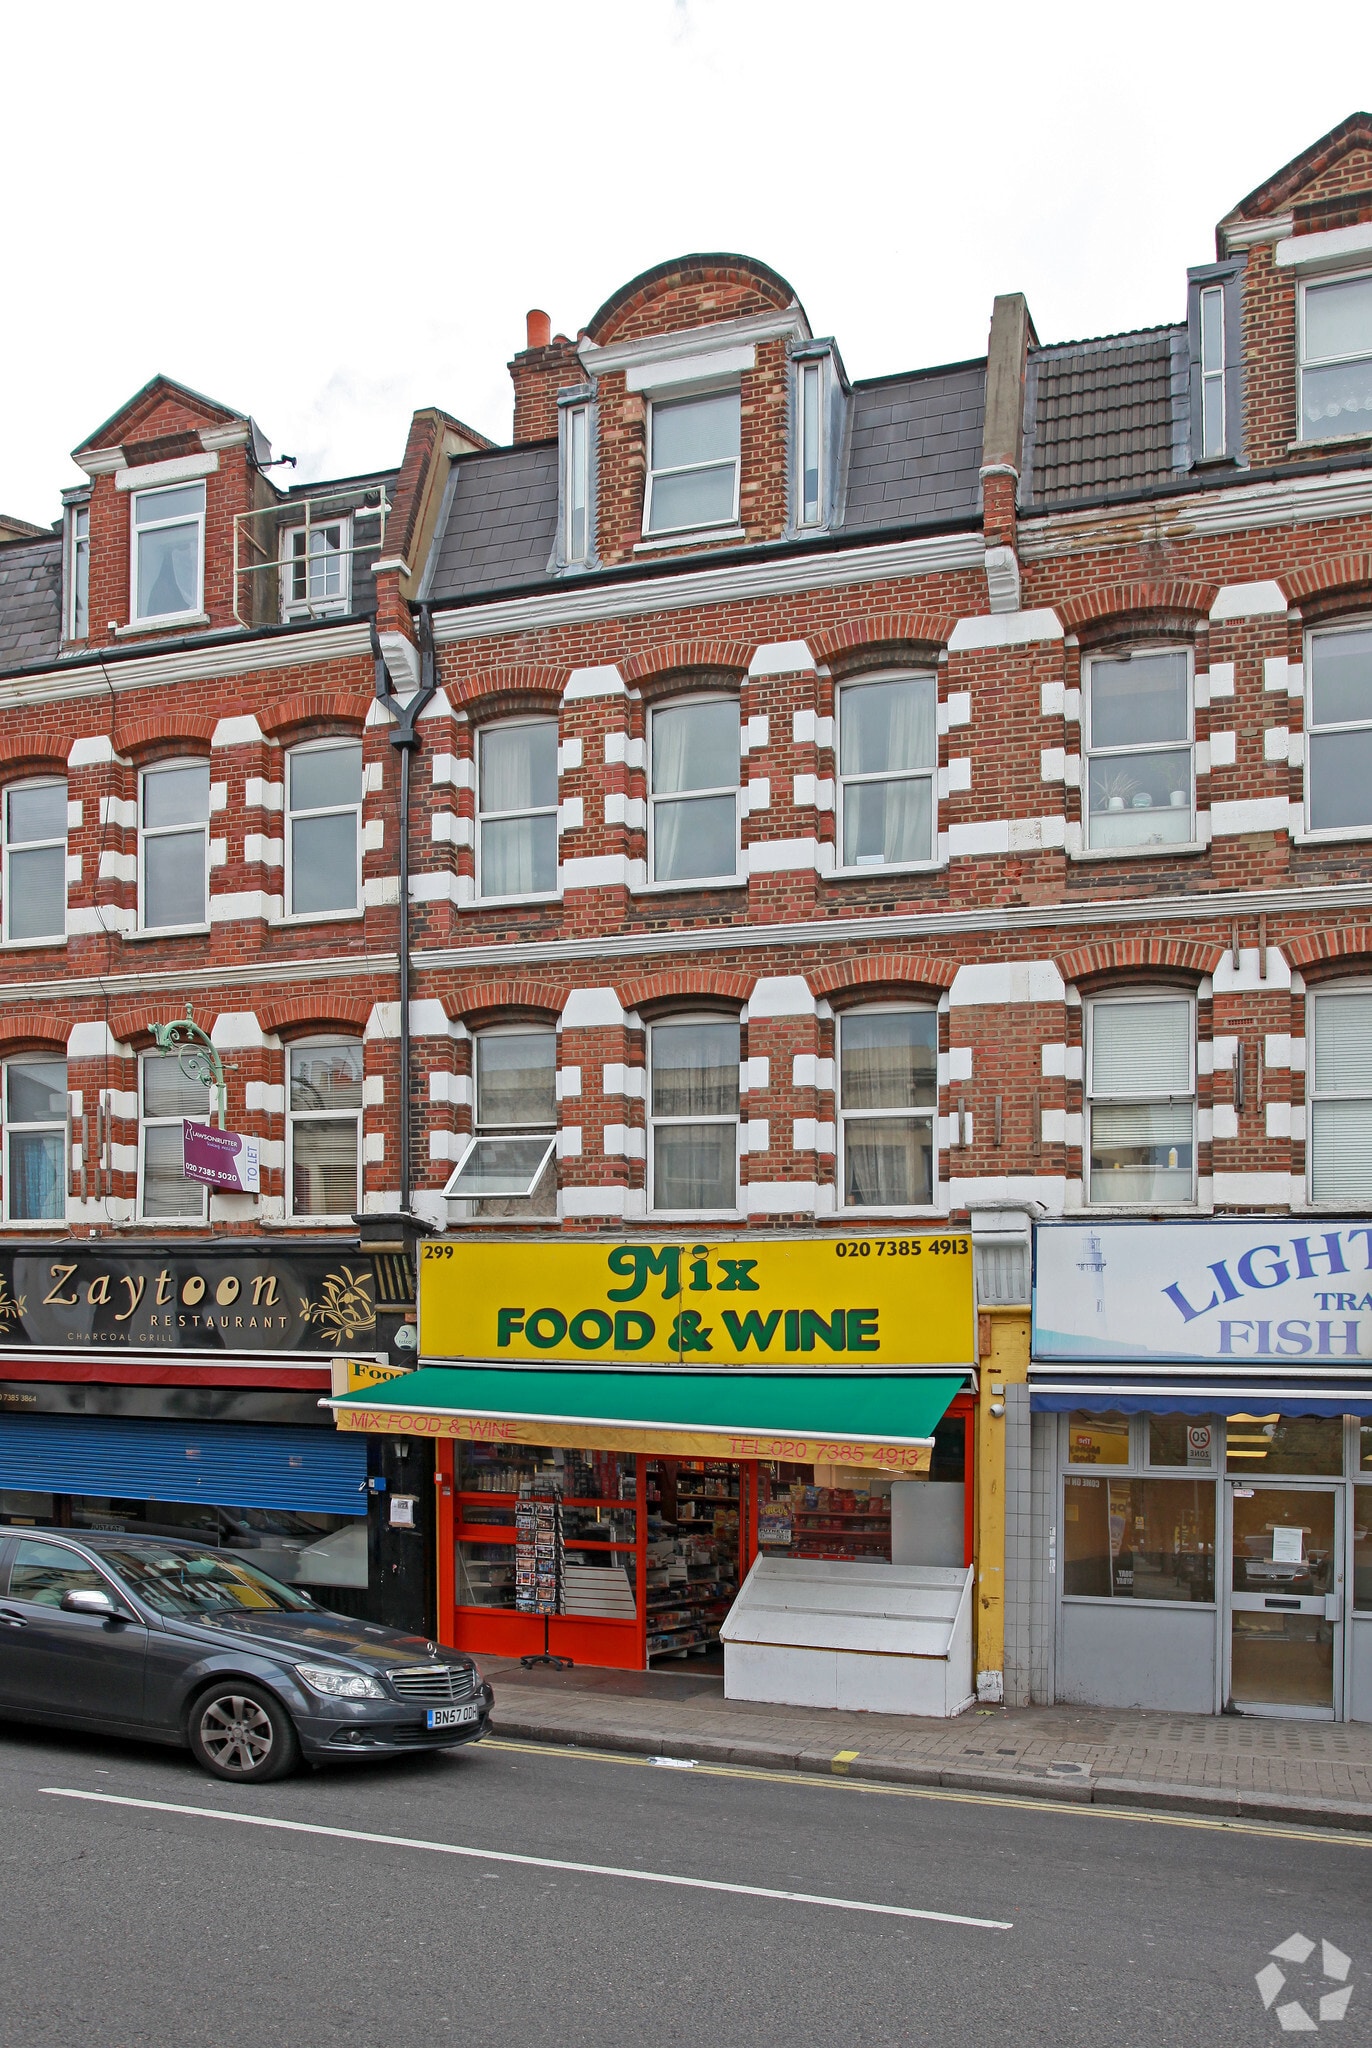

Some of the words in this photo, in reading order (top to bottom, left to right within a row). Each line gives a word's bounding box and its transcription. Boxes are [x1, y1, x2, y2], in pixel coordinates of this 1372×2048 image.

[247, 1146, 258, 1165] LET
[185, 1162, 197, 1172] 020
[198, 1166, 216, 1177] 7385
[217, 1171, 238, 1182] 5020
[247, 1167, 258, 1182] TO
[424, 1245, 454, 1259] 299
[835, 1242, 868, 1257] 020
[875, 1240, 922, 1257] 7385
[928, 1239, 969, 1255] 4913
[606, 1244, 760, 1303] Mix
[42, 1263, 281, 1321] Zaytoon
[150, 1315, 288, 1328] RESTAURANT
[497, 1307, 656, 1351] FOOD
[667, 1309, 714, 1353] &
[721, 1308, 881, 1352] WINE
[67, 1332, 132, 1342] CHARCOAL
[139, 1333, 173, 1342] GRILL
[1218, 1320, 1362, 1355] FISH
[353, 1363, 407, 1381] Foo
[3, 1393, 19, 1402] 7385
[20, 1394, 37, 1402] 3864
[350, 1412, 382, 1429] MIX
[387, 1415, 442, 1433] FOOD
[448, 1418, 461, 1435] &
[468, 1420, 518, 1440] WINE
[815, 1444, 864, 1462] 7385
[872, 1447, 919, 1466] 4913
[434, 1709, 462, 1725] BN57
